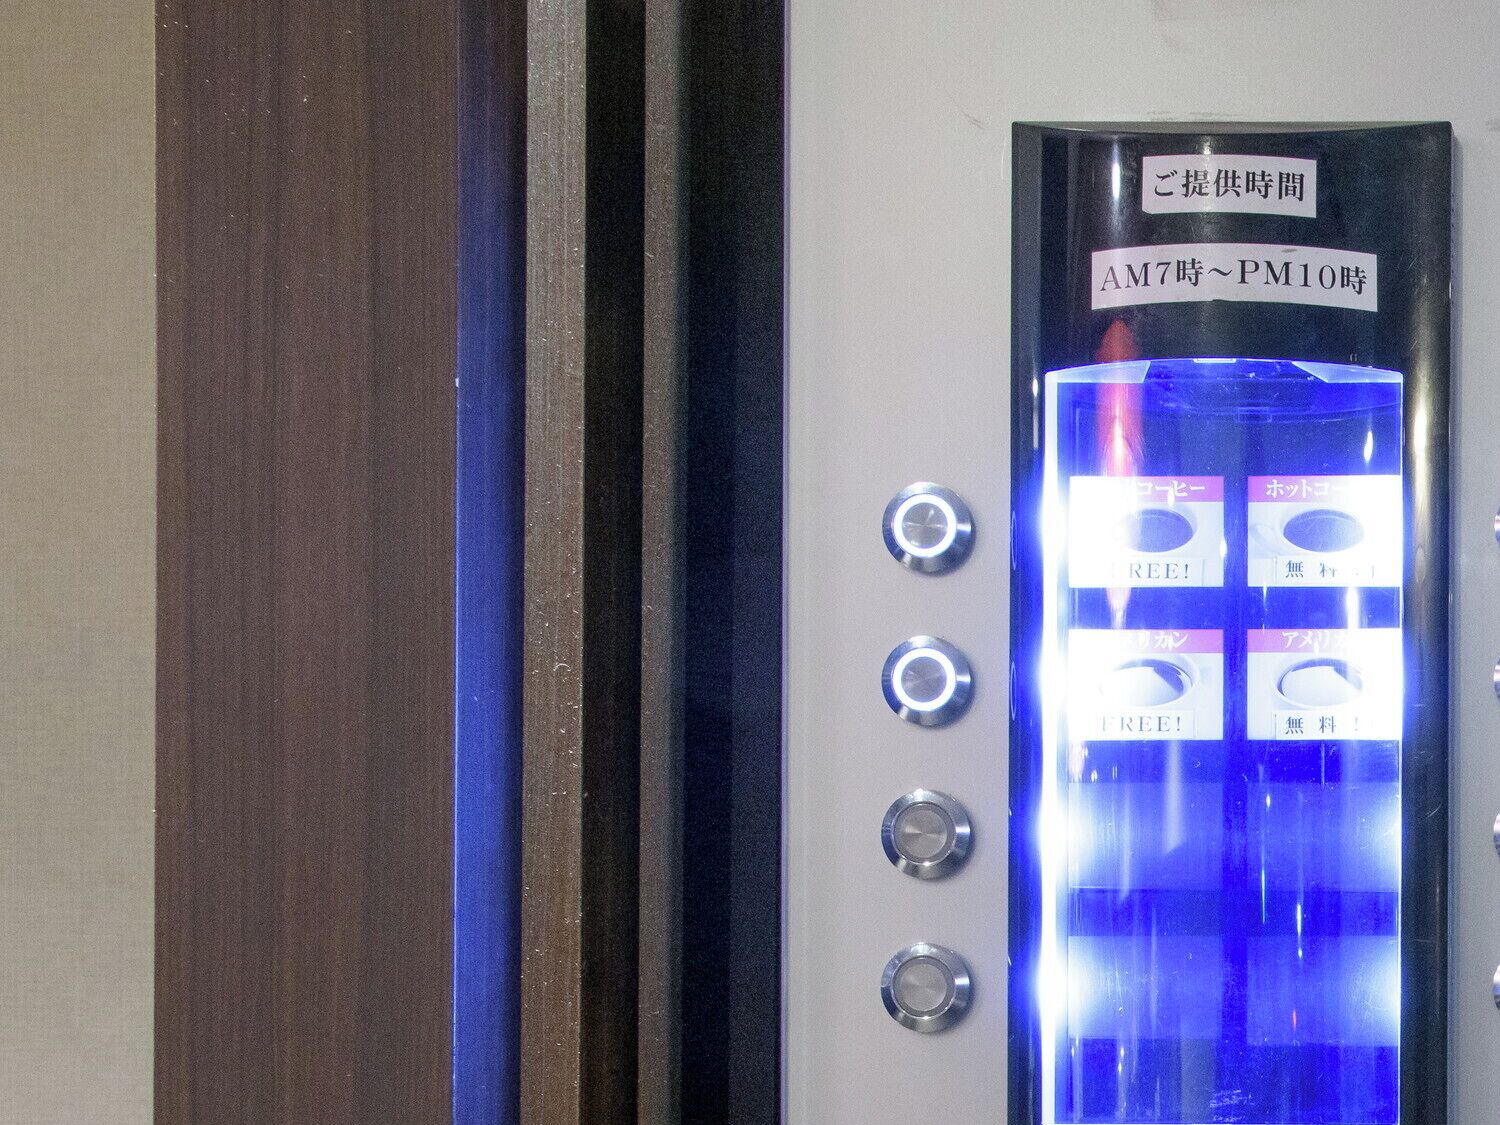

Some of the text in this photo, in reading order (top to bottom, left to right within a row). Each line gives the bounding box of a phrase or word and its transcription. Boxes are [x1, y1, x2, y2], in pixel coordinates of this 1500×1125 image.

[1154, 168, 1305, 202] ご提供時間
[1137, 480, 1206, 497] コーヒー
[1266, 479, 1346, 499] ホットコー
[1112, 562, 1189, 579] REE!
